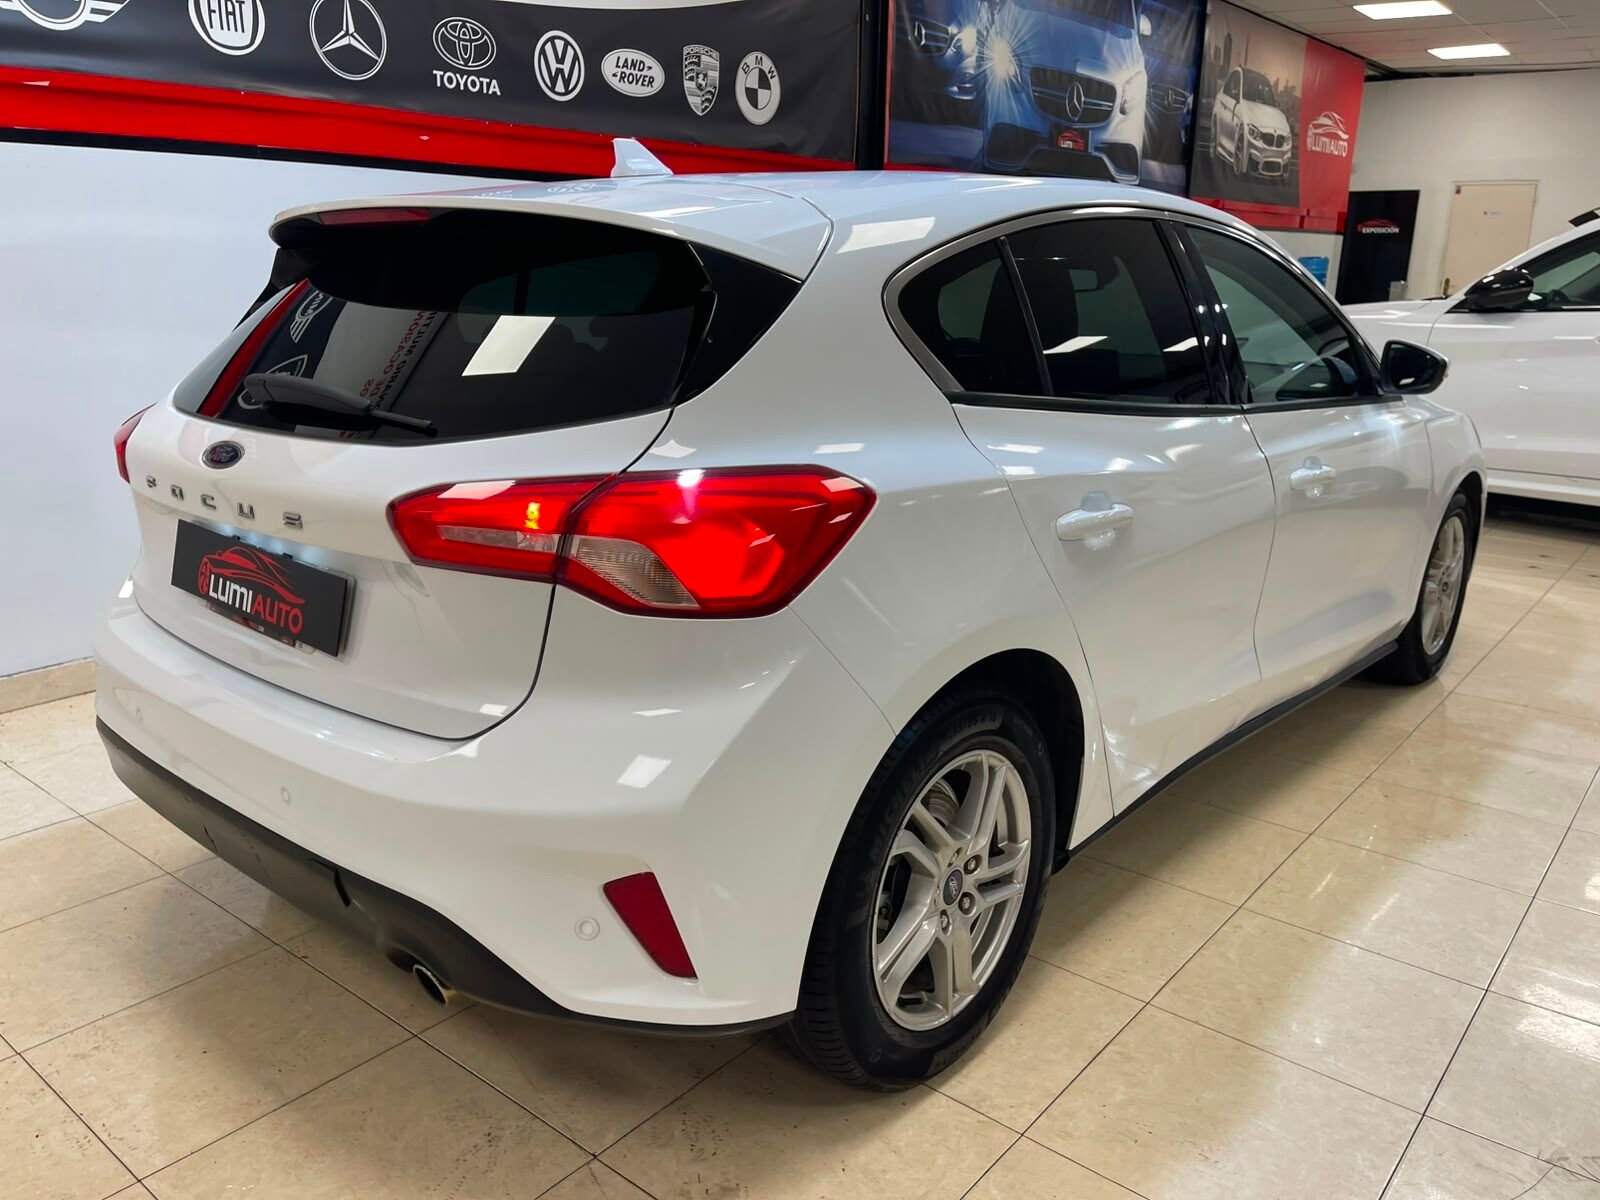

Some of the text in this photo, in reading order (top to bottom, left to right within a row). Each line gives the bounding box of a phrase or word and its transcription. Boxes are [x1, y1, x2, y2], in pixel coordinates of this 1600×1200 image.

[207, 0, 246, 33] FIAT
[615, 56, 646, 72] LAND
[741, 55, 776, 80] BMW
[433, 70, 501, 96] TOYOTA
[618, 71, 655, 88] ROVER
